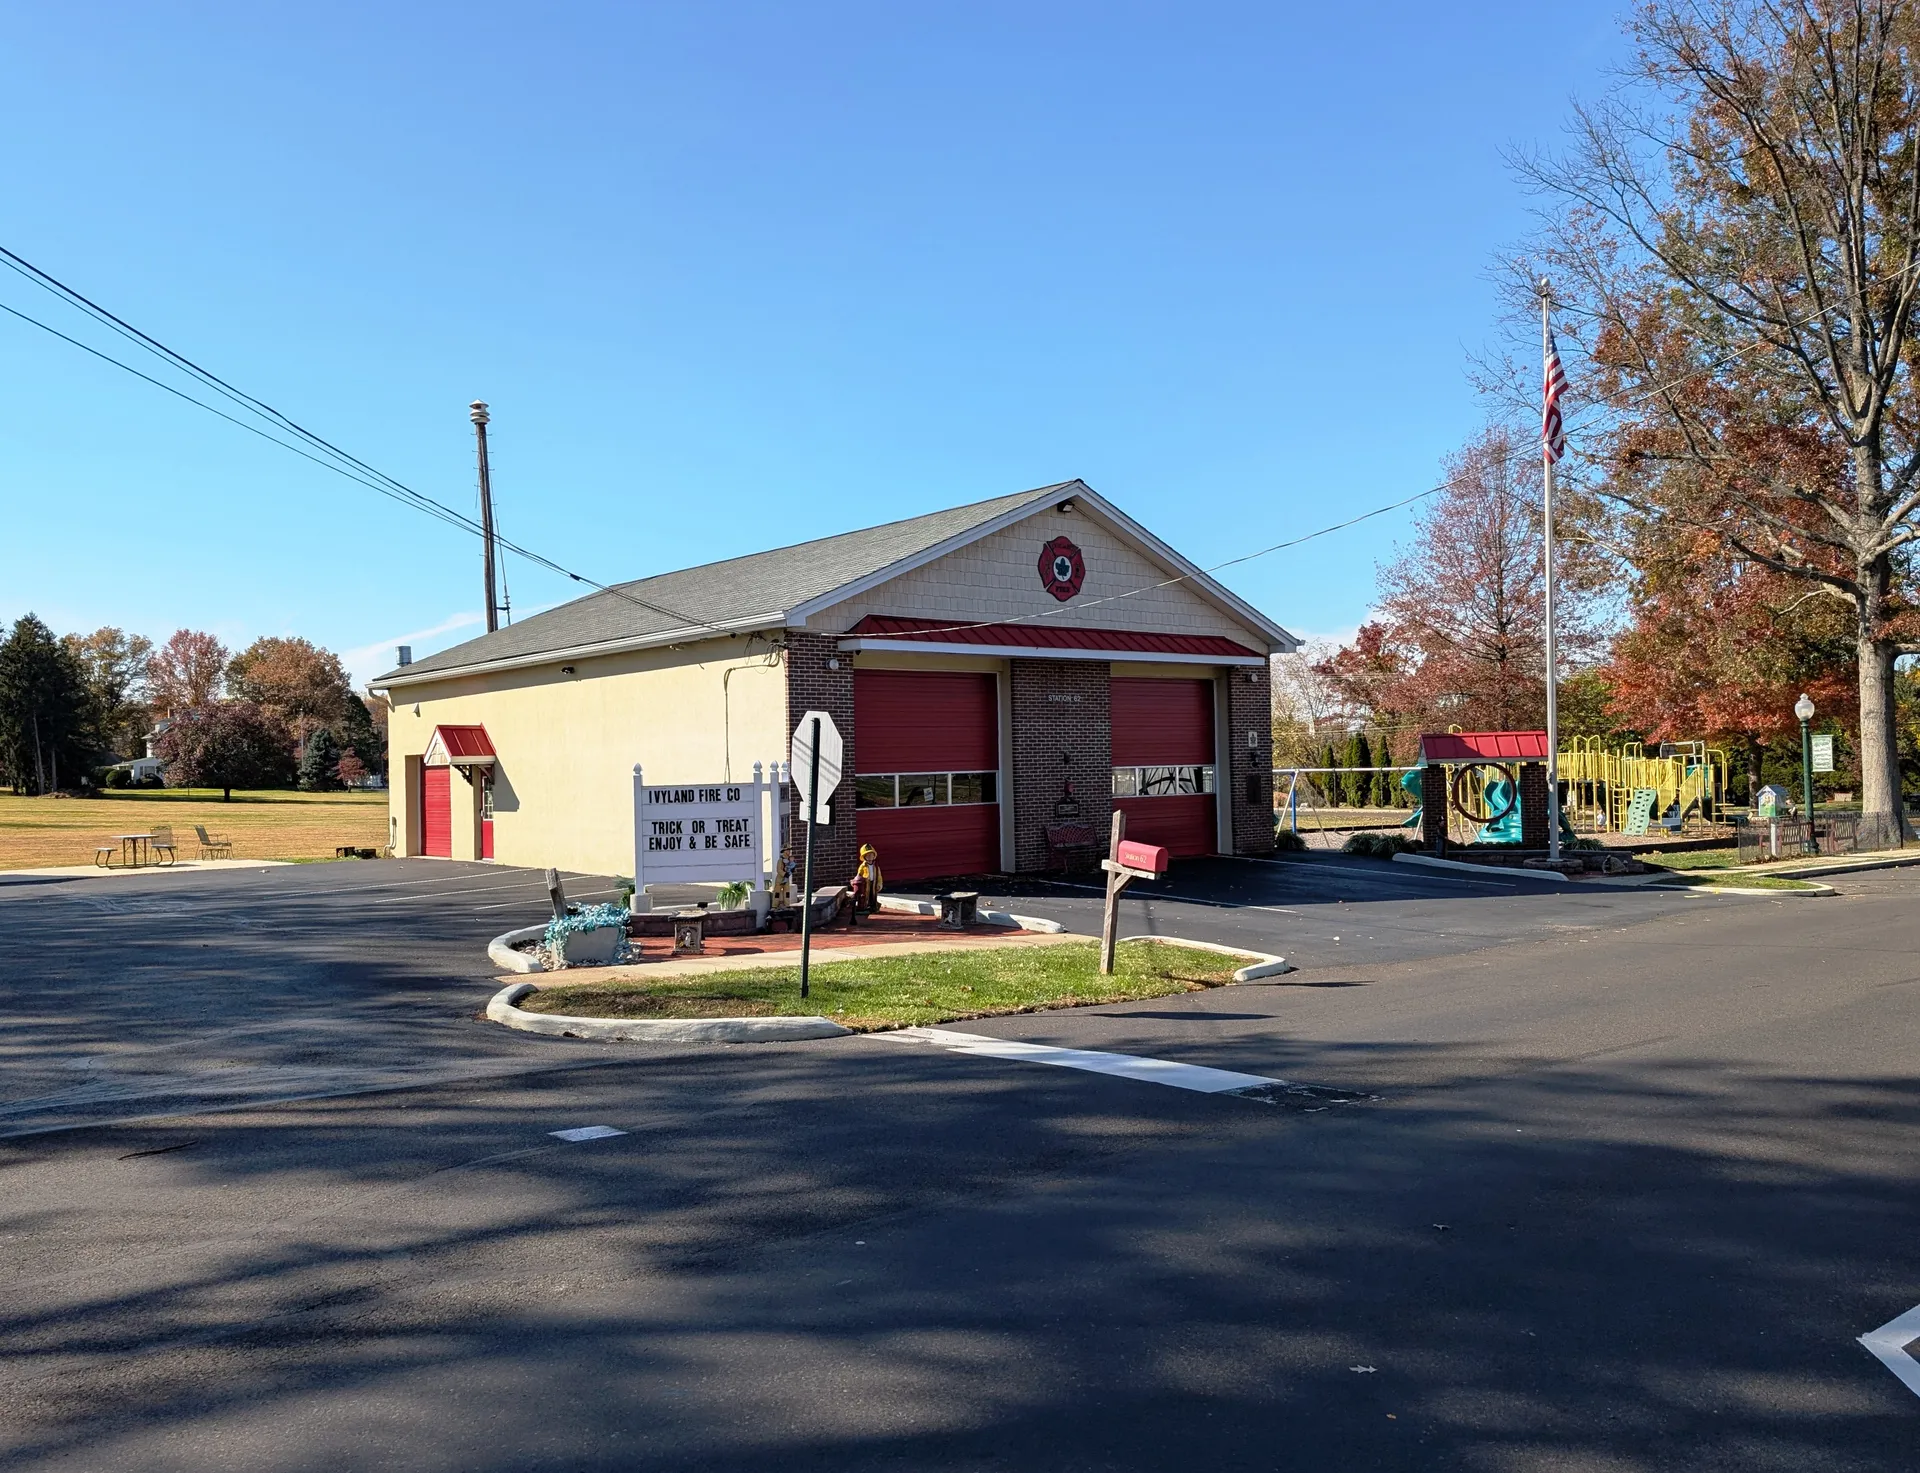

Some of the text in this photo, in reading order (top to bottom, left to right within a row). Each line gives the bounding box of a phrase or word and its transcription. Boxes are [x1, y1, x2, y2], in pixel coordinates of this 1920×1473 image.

[649, 788, 740, 803] IVYLAND FIRE CO
[652, 819, 749, 834] TRICK OR TREAT
[649, 834, 750, 851] ENJOY & BE SAFE
[1139, 854, 1147, 863] 62
